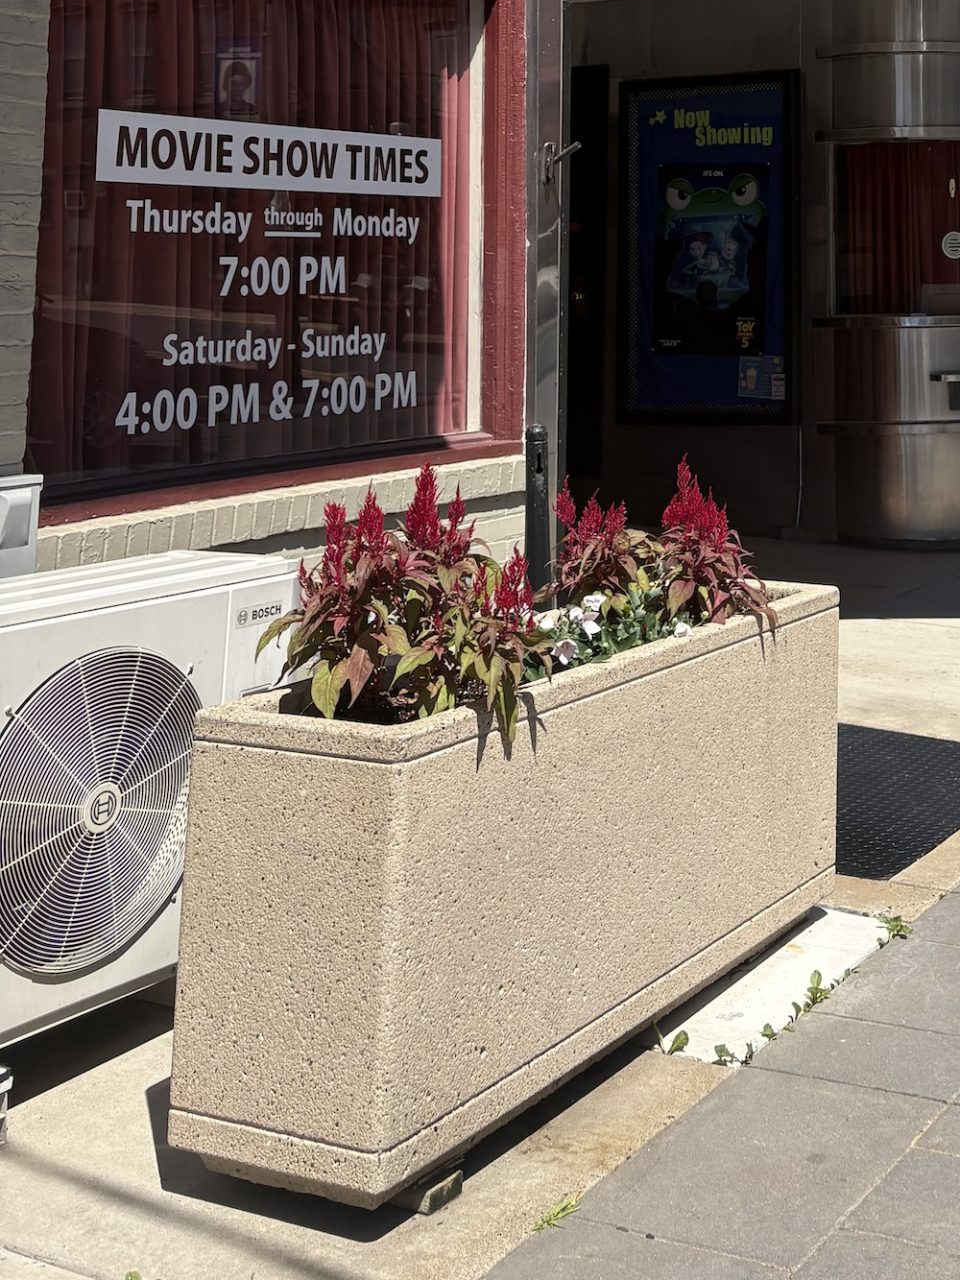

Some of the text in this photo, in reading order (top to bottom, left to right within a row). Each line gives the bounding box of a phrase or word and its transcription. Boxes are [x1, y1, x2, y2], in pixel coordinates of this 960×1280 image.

[673, 108, 710, 129] Now
[695, 122, 773, 147] Showing
[115, 125, 429, 184] MOVIE SHOW TIMES
[125, 199, 420, 245] Thursday through Monday
[218, 256, 346, 297] 7:00 PM
[735, 320, 756, 332] TOY
[162, 330, 282, 369] Saturday
[301, 325, 387, 363] Sunday
[740, 337, 750, 349] 5
[114, 370, 418, 435] 4:00 PM & 7:00 PM
[252, 605, 281, 620] BOSCH
